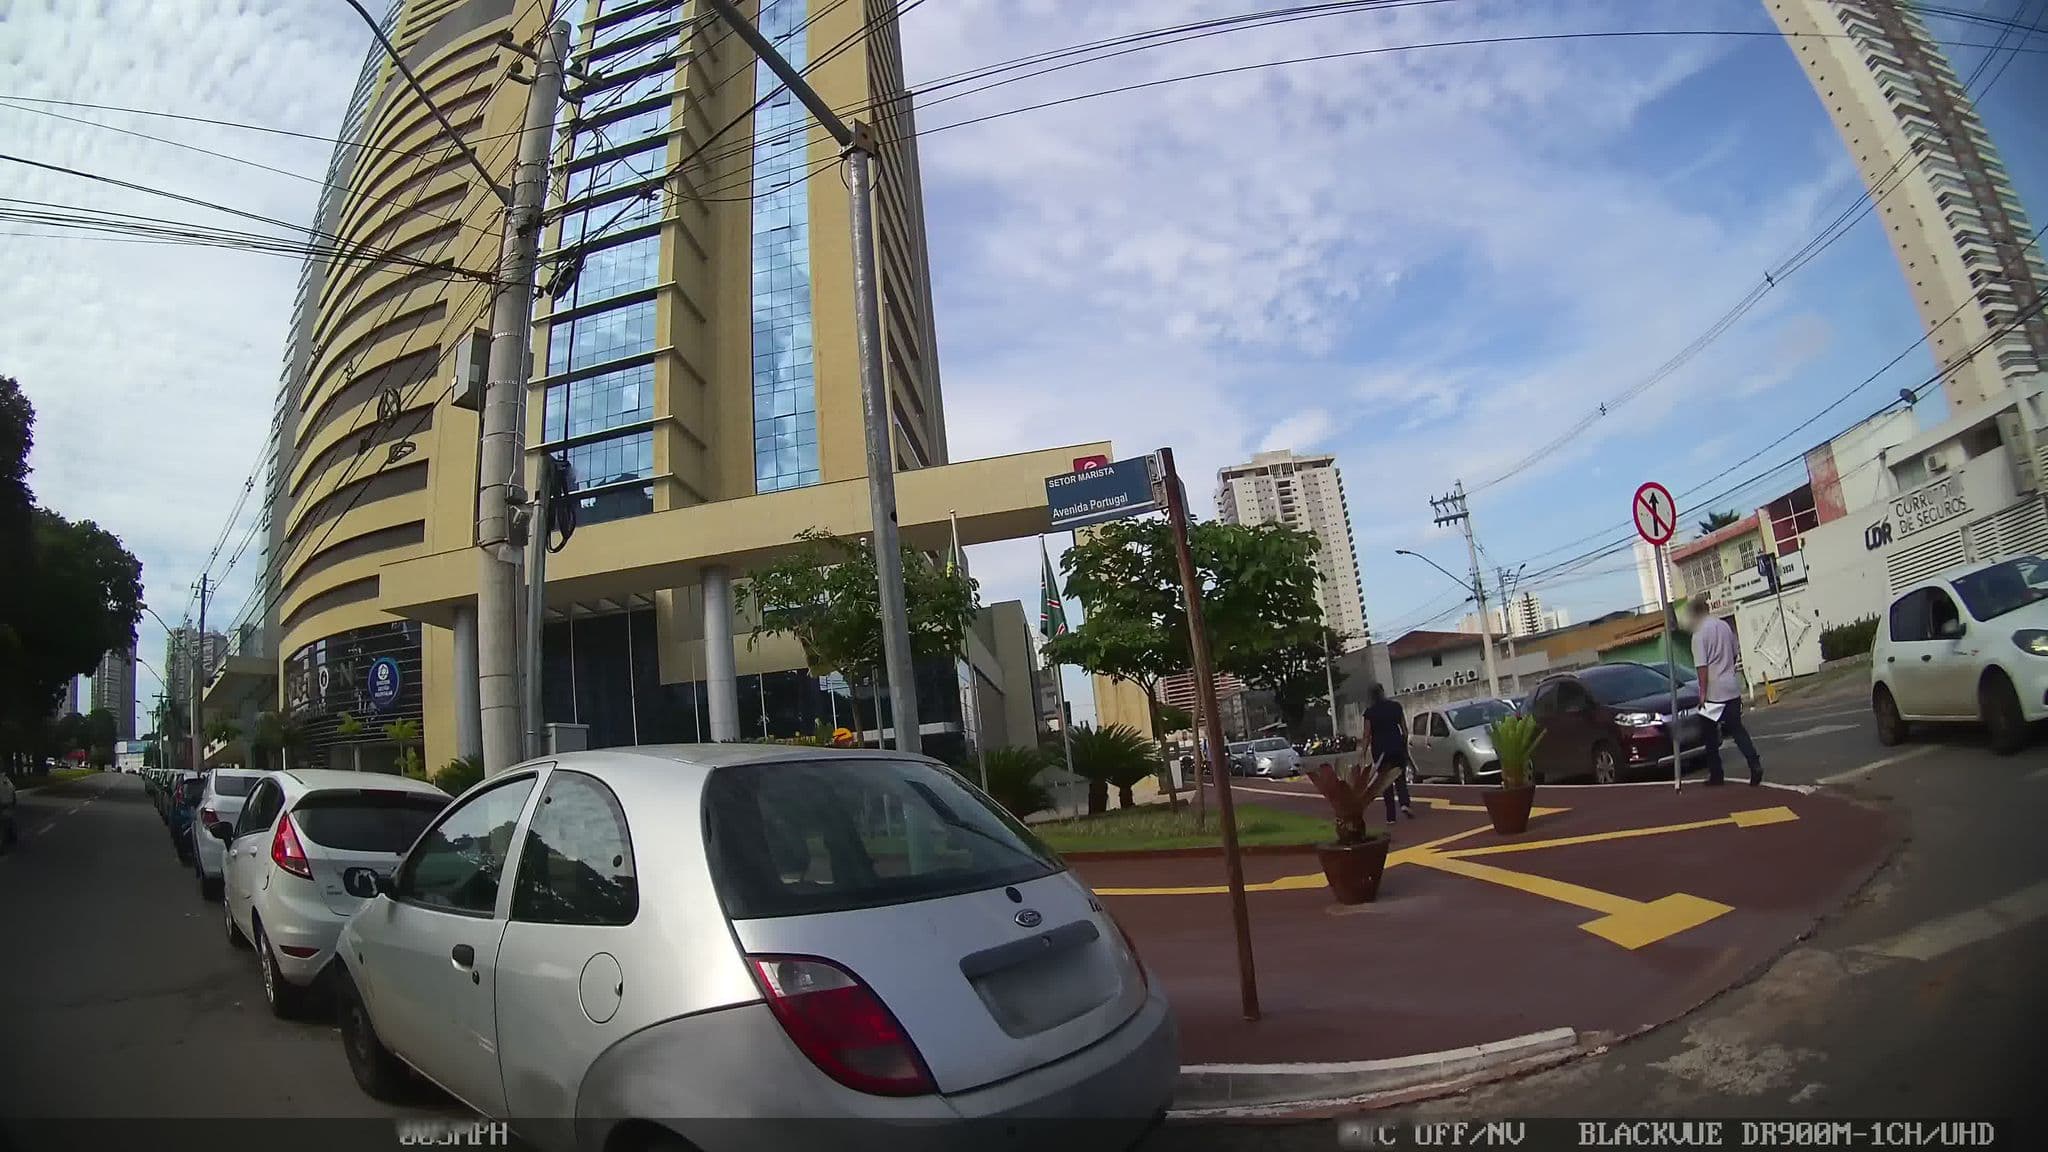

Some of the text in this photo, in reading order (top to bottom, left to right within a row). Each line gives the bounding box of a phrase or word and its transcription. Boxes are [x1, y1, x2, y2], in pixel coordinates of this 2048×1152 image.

[1048, 467, 1115, 488] SETOR MARISTA
[1053, 492, 1128, 518] Avenida Portugal
[1899, 517, 1915, 534] DE
